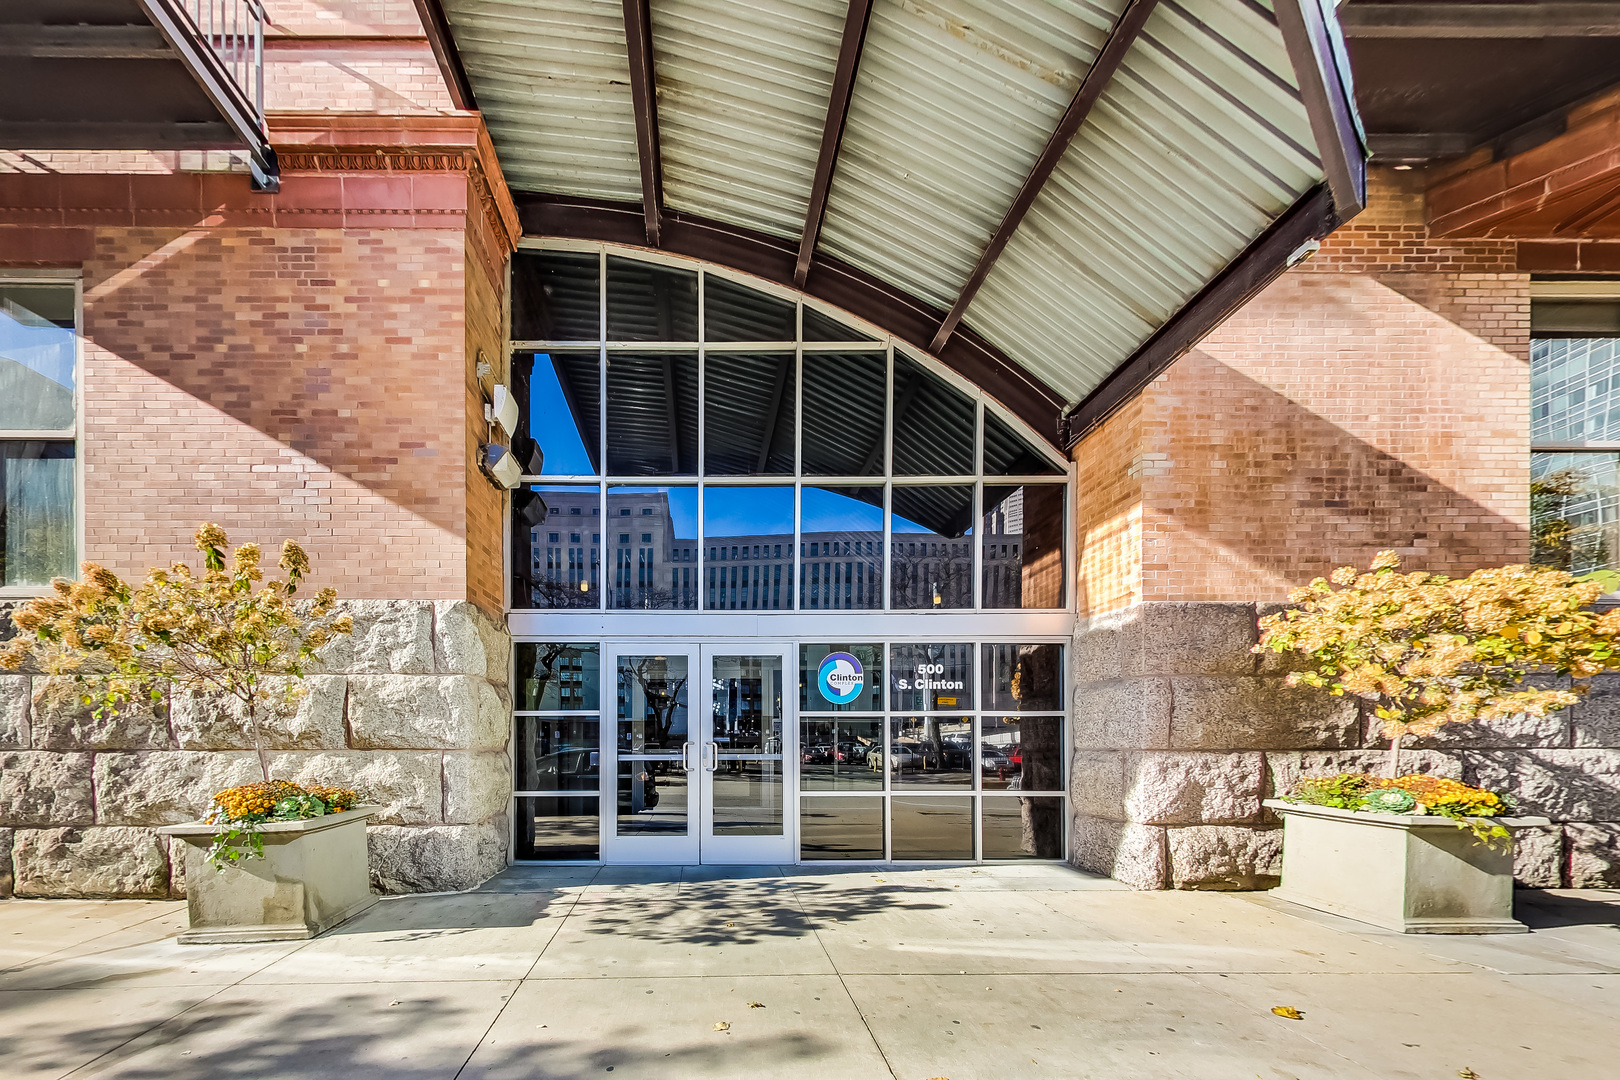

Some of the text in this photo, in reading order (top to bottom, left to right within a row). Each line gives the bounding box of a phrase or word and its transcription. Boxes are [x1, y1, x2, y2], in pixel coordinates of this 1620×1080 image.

[917, 664, 944, 674] 500
[830, 673, 863, 681] Clinton
[898, 679, 964, 690] S. Clinton
